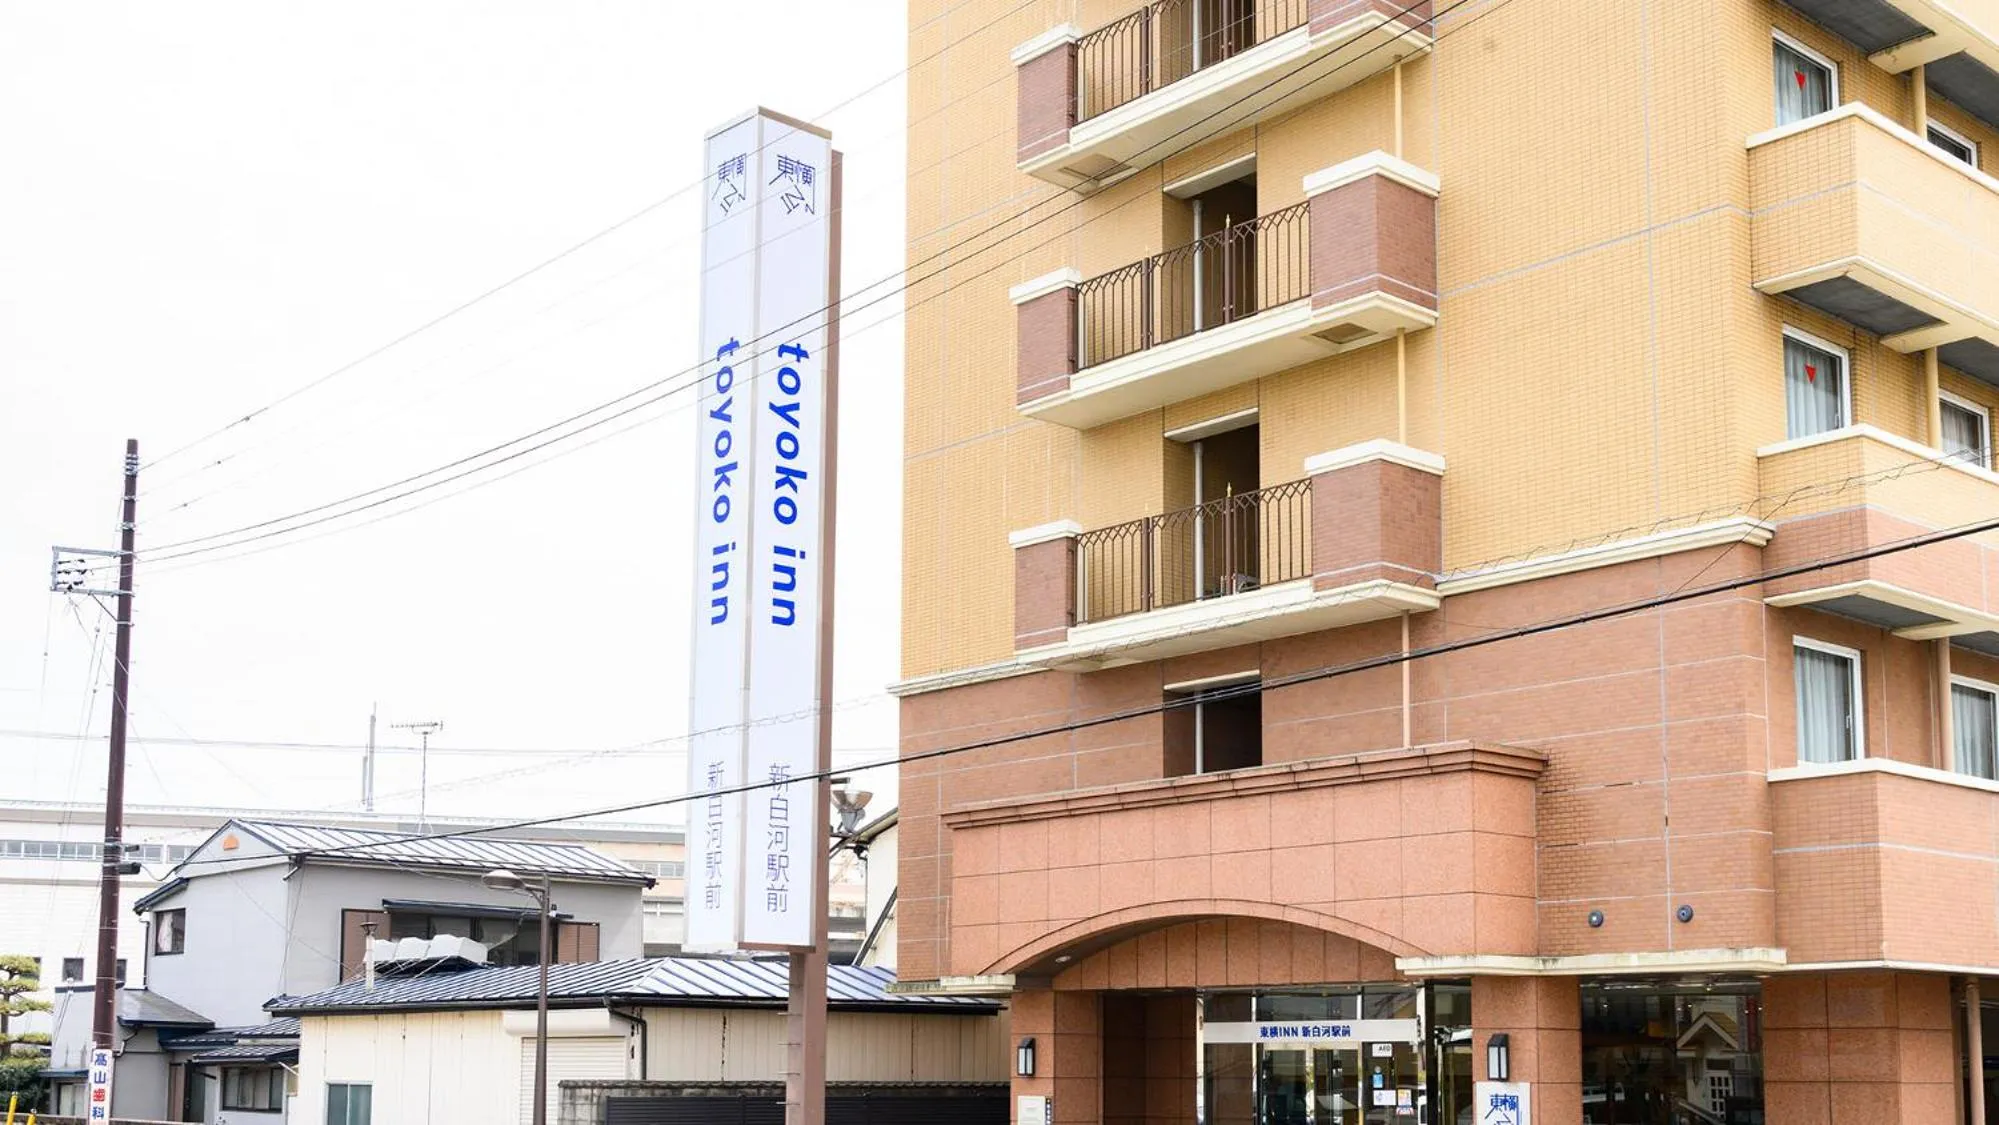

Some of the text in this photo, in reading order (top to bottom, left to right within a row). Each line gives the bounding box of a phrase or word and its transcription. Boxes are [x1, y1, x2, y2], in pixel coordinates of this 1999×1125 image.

[710, 337, 740, 625] toyoko inn
[769, 343, 809, 627] toyoko inn
[705, 761, 724, 910] 新白河駅前
[766, 763, 790, 913] 新白河駅前
[1260, 1025, 1351, 1038] 東横INN 新白河駅前
